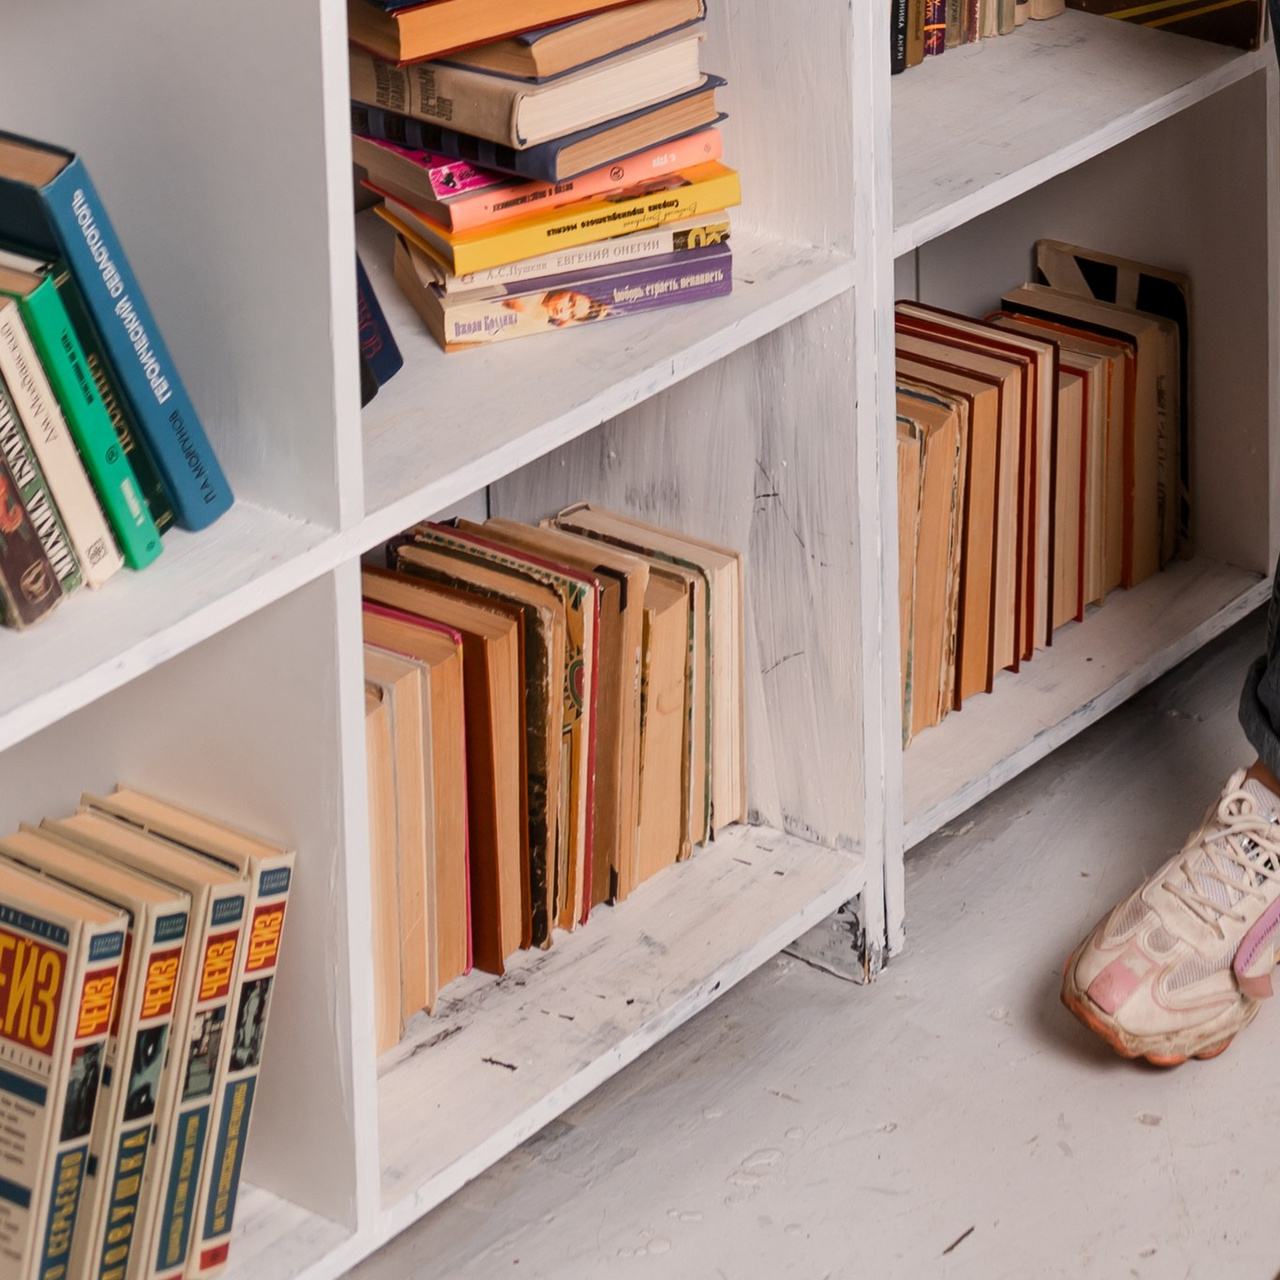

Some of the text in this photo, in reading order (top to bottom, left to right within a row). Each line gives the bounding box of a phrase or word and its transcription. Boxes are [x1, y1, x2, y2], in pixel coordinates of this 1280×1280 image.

[413, 64, 441, 116] ВЕЧНЫЙ
[434, 93, 455, 123] ЗОВ
[544, 220, 578, 237] месяца
[578, 205, 645, 229] тринадцатого
[646, 198, 680, 212] Страна
[72, 188, 127, 305] СЕВАСТОПОЛЬ
[554, 246, 611, 270] ЕВГЕНИЙ
[611, 236, 661, 259] ОНЕГИН
[115, 296, 172, 404] ГЕРОИЧЕСКИЙ
[164, 408, 207, 479] МОРГУНОВ
[20, 484, 79, 585] МИХАИЛ
[200, 939, 236, 1001] ЧЕЙЗ
[247, 910, 283, 970] ЧЕЙЗ
[77, 974, 115, 1037] ЧЕЙЗ
[142, 957, 180, 1018] ЧЕЙЗ
